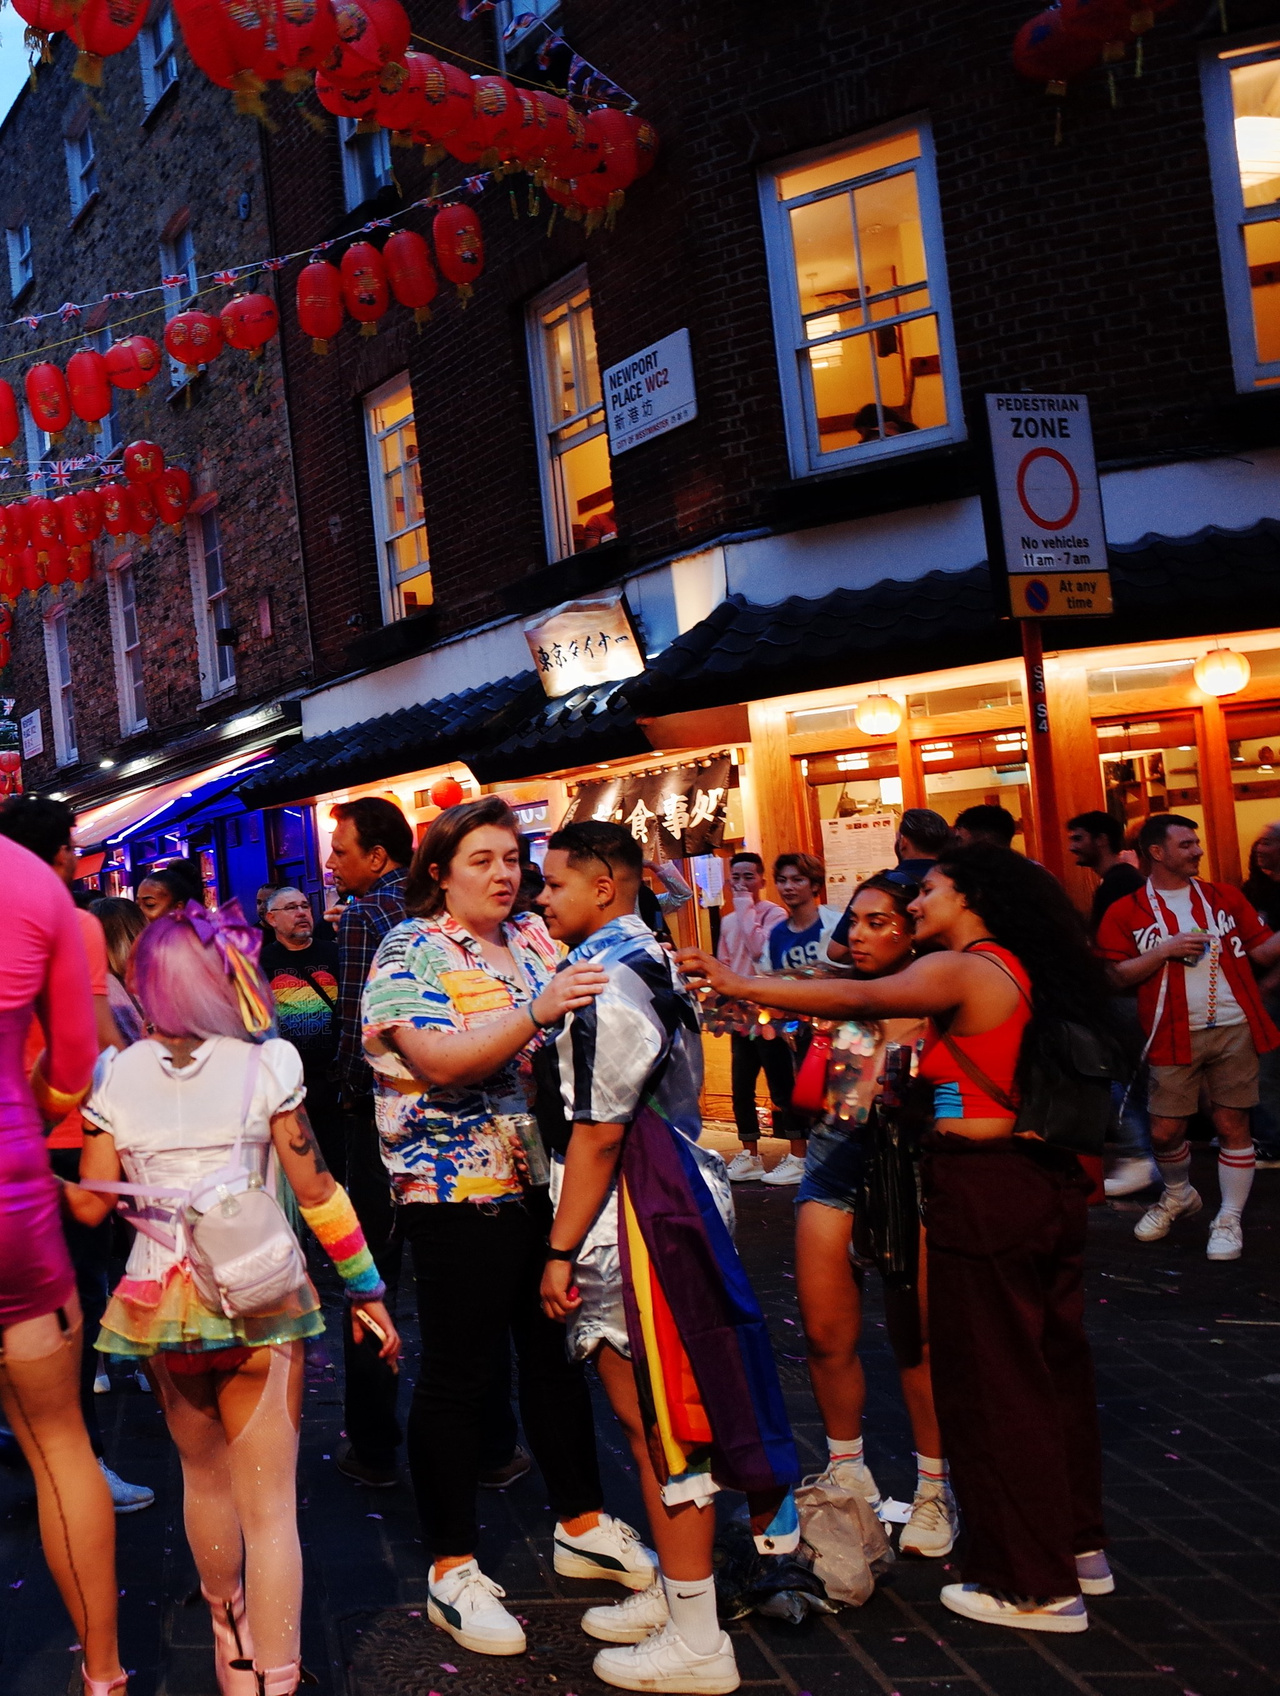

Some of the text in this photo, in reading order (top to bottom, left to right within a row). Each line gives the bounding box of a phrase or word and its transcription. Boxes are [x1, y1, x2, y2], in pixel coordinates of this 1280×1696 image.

[609, 350, 659, 391] NEWPORT
[611, 367, 670, 411] PLACE WC2
[996, 397, 1080, 412] PEDESTRIAN
[1010, 417, 1071, 439] ZONE
[1021, 536, 1090, 550] No vehicles
[1059, 579, 1097, 594] At any
[1067, 596, 1093, 609] time
[1037, 703, 1048, 733] S4
[1231, 936, 1246, 958] 2
[280, 1020, 332, 1036] PRIDE
